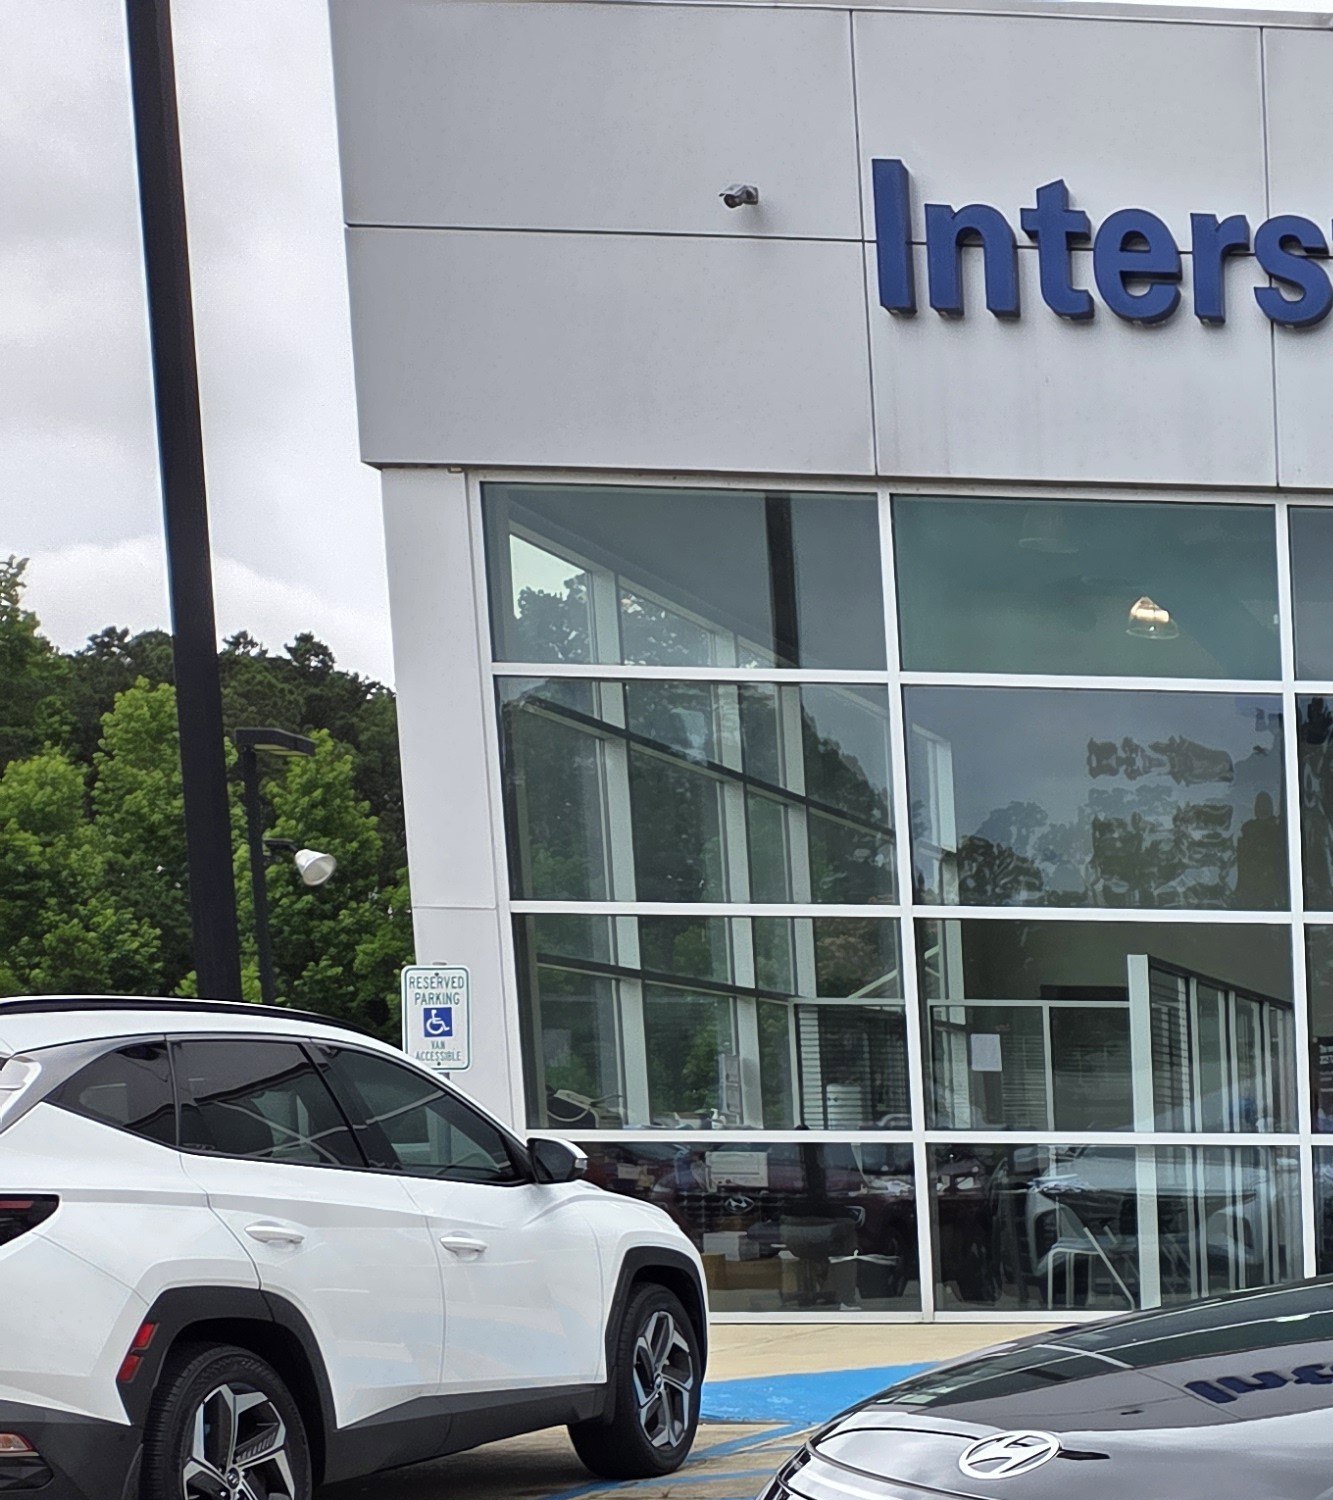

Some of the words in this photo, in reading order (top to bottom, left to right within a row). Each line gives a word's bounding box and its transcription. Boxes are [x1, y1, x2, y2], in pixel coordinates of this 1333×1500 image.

[408, 976, 464, 989] RESERVED
[414, 992, 460, 1006] PARKING
[431, 1041, 446, 1050] VAN
[415, 1051, 461, 1062] ACCESSIBLE
